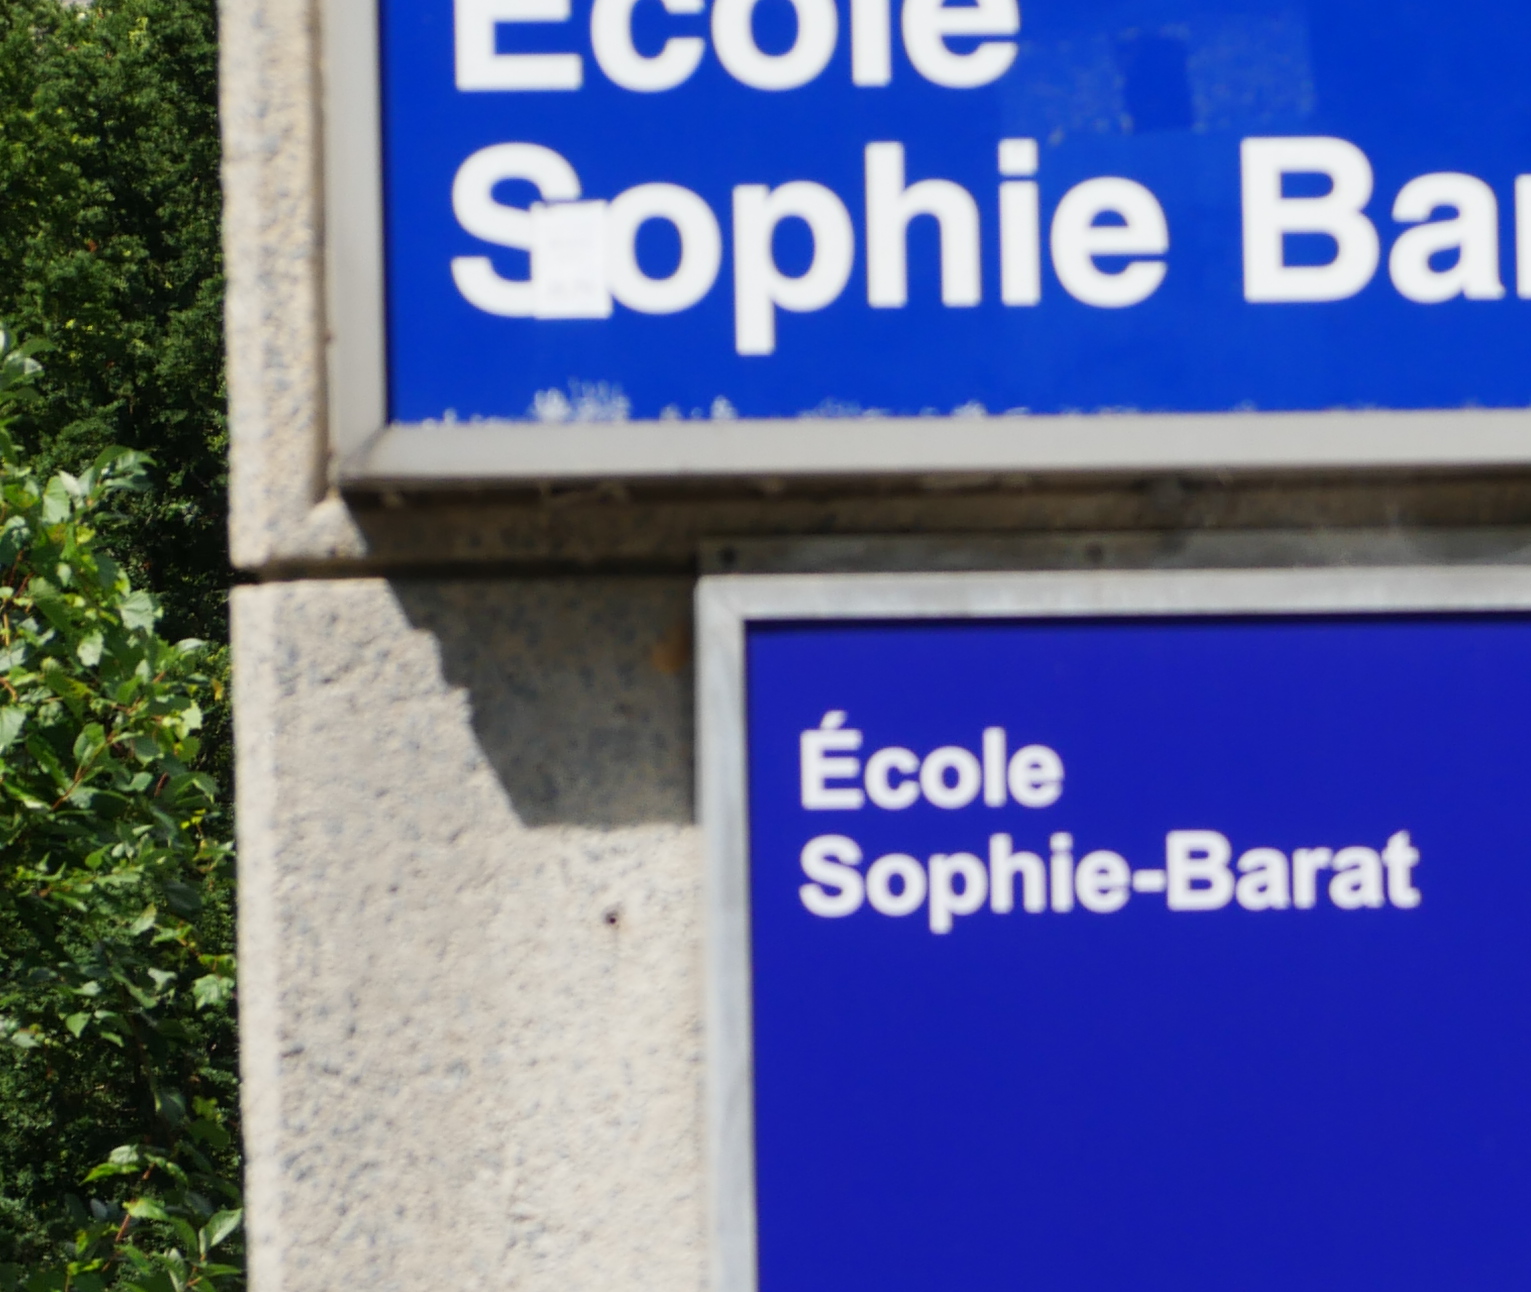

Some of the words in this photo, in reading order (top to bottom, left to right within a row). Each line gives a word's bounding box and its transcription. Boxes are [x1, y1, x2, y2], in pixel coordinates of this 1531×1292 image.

[450, 137, 1169, 356] Sophie
[799, 710, 1065, 811] École
[799, 829, 1421, 935] Sophie-Barat
